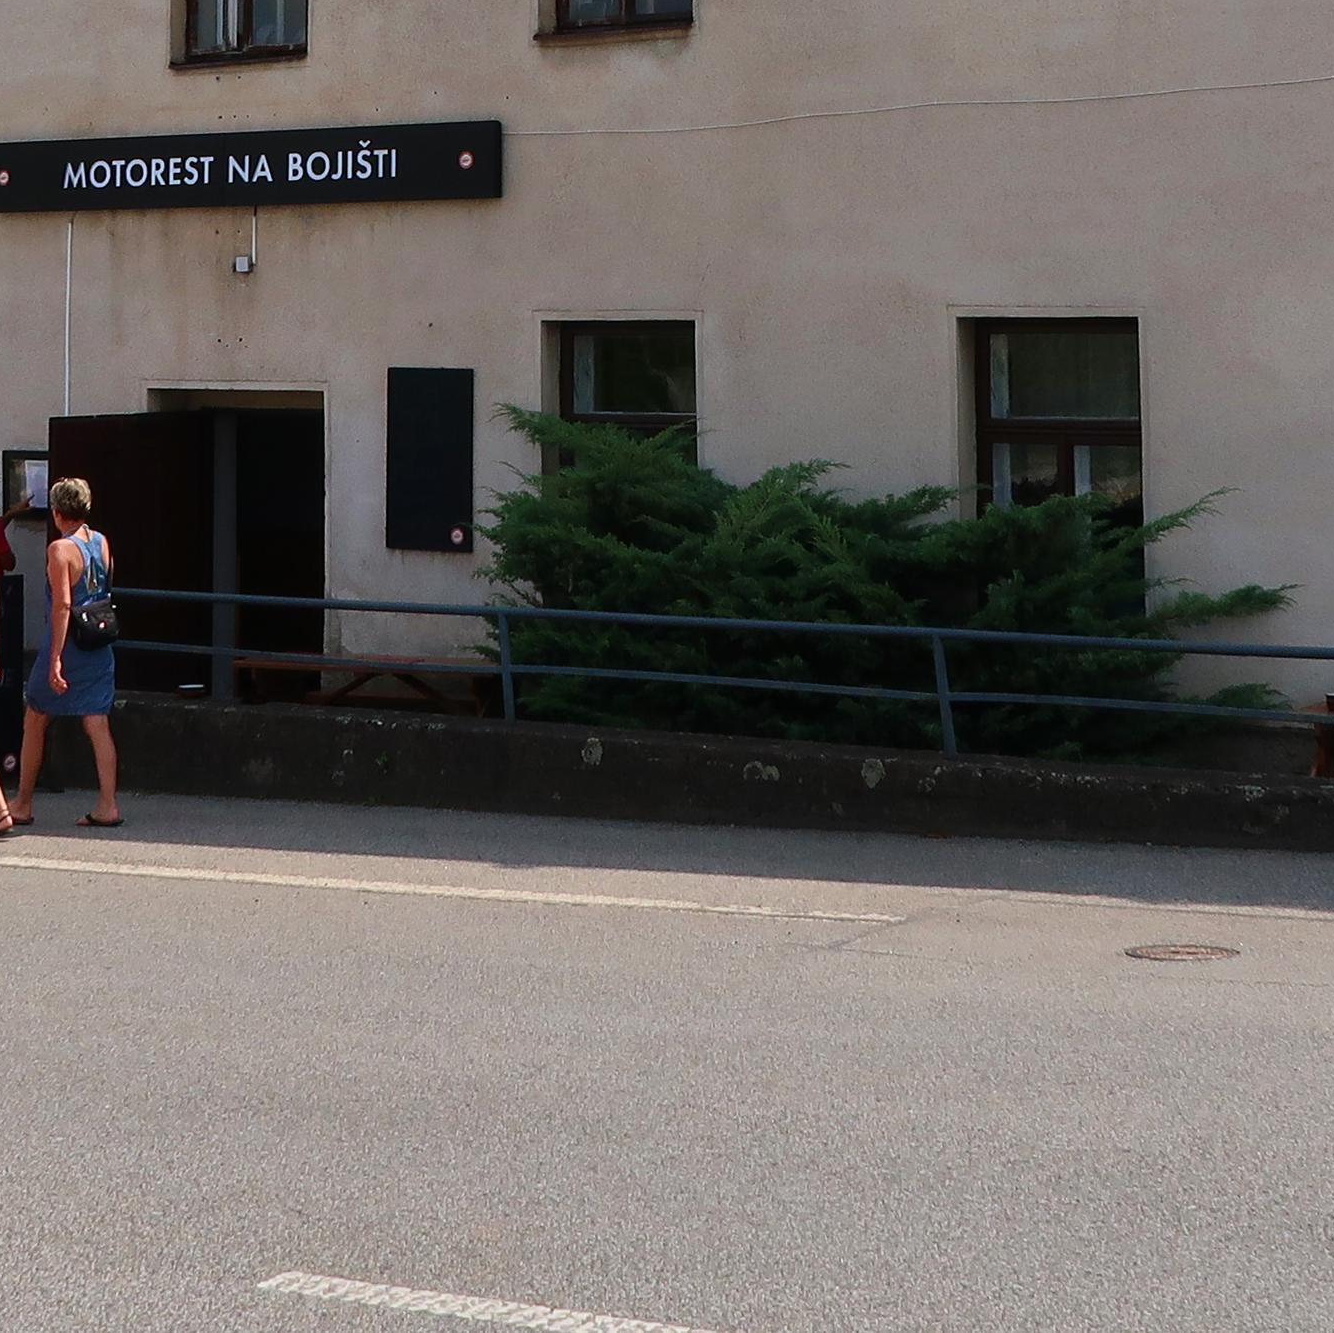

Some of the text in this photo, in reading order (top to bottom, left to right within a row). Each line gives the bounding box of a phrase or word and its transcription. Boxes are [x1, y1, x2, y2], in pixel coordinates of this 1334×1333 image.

[63, 139, 397, 189] MOTOREST NA BOJIŠTI
